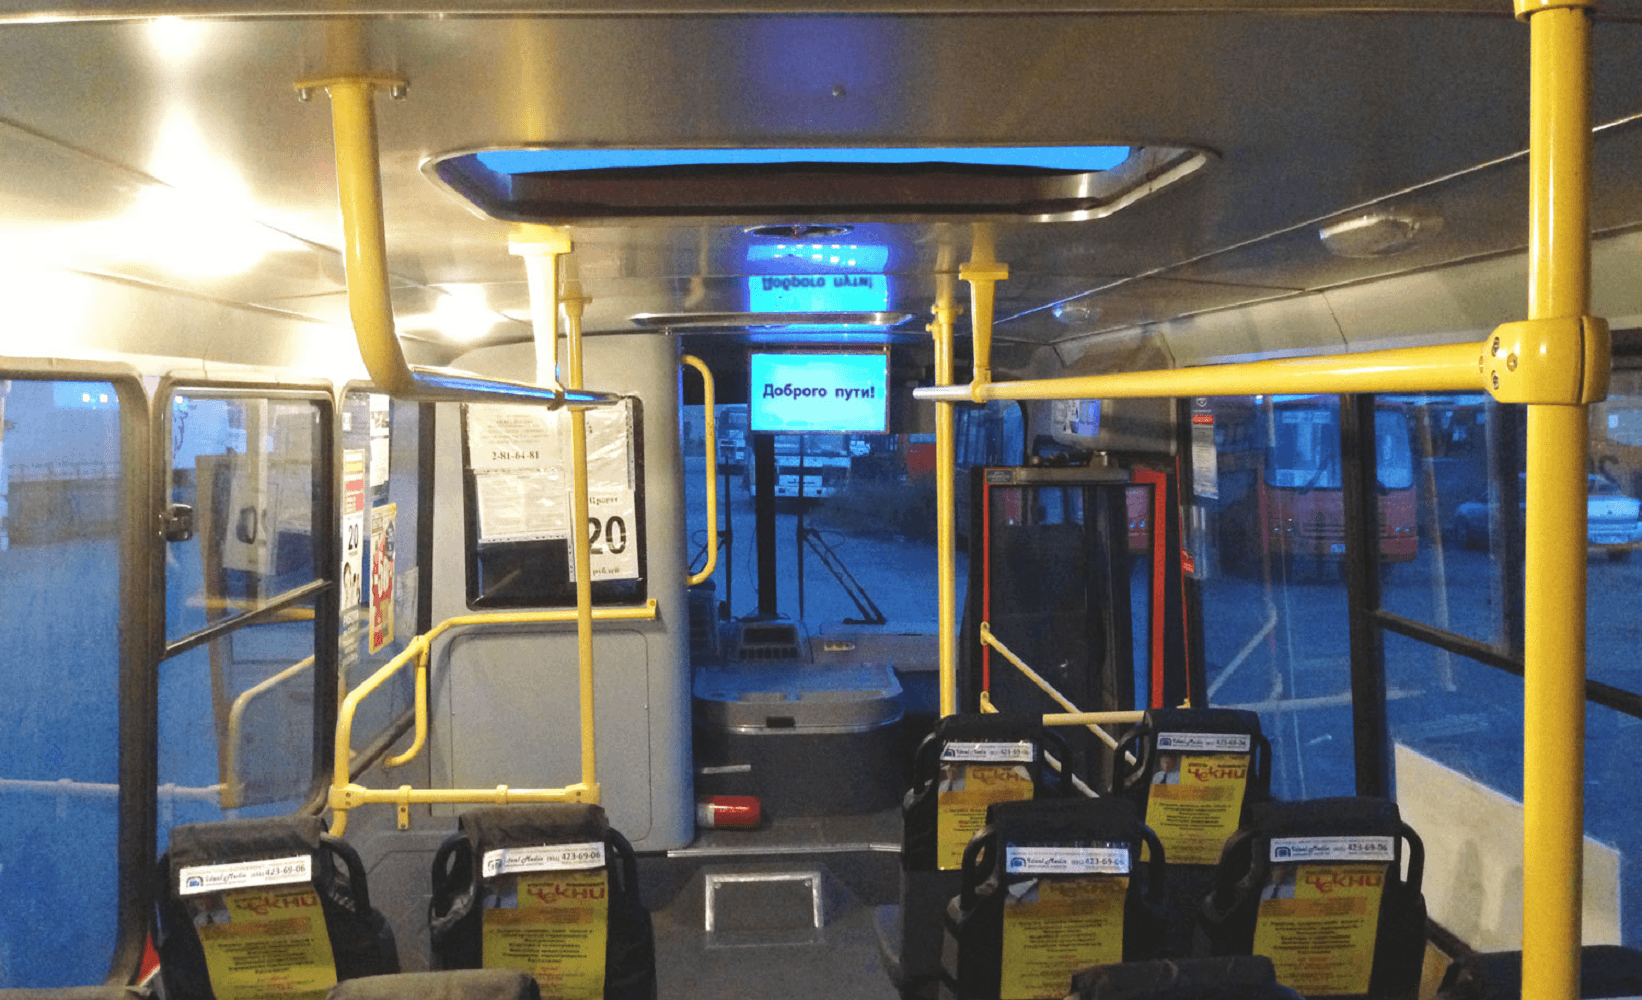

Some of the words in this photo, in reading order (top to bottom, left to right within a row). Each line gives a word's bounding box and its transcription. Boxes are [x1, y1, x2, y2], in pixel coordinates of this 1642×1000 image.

[763, 383, 827, 400] Доброго
[835, 385, 875, 401] пути!
[492, 450, 540, 460] 2-81-64-81
[348, 523, 359, 550] 20
[588, 515, 627, 554] 20
[562, 851, 601, 861] 423-69-06
[265, 864, 306, 876] 423-69-06
